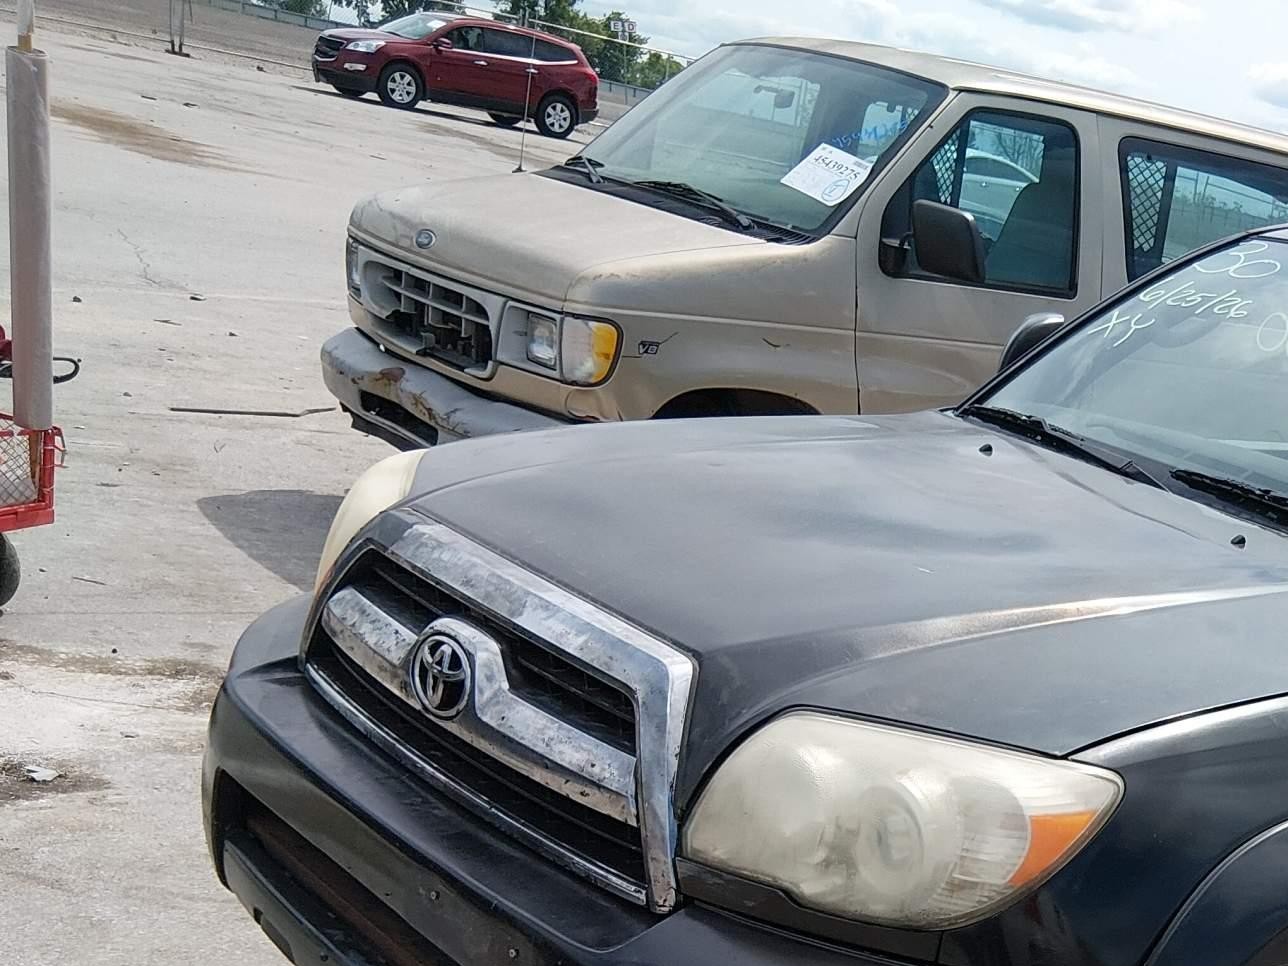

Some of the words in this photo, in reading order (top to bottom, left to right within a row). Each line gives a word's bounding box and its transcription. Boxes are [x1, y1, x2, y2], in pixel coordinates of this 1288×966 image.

[814, 155, 861, 180] 45439275
[1192, 242, 1281, 279] 30
[1138, 276, 1254, 320] 6/25/26
[639, 343, 658, 354] V8
